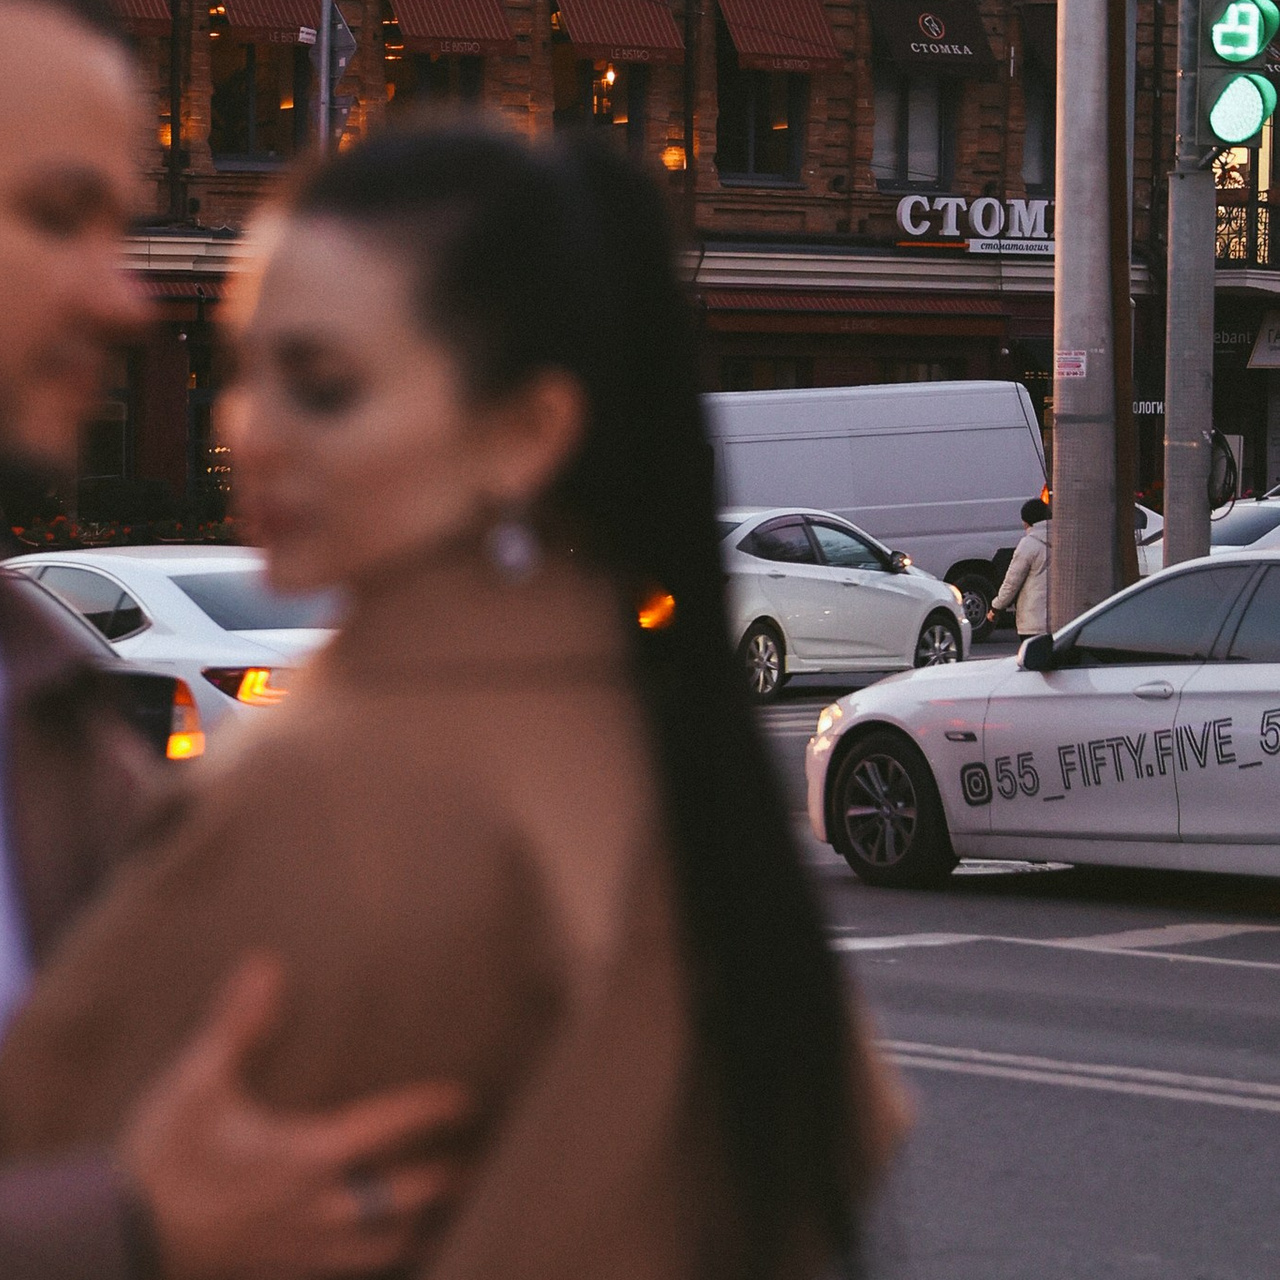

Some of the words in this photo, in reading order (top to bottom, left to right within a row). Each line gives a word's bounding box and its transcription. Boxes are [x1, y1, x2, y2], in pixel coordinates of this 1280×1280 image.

[440, 41, 450, 53] LE
[452, 41, 480, 54] BISTRO
[911, 42, 973, 55] СТОМКА
[611, 48, 620, 59] LE
[622, 48, 650, 61] BISTRO
[773, 58, 782, 69] LE
[784, 59, 810, 71] BISTRO
[896, 195, 1055, 238] СТОМ
[980, 242, 1049, 252] стоматология
[1132, 401, 1165, 414] ОЛОГИ
